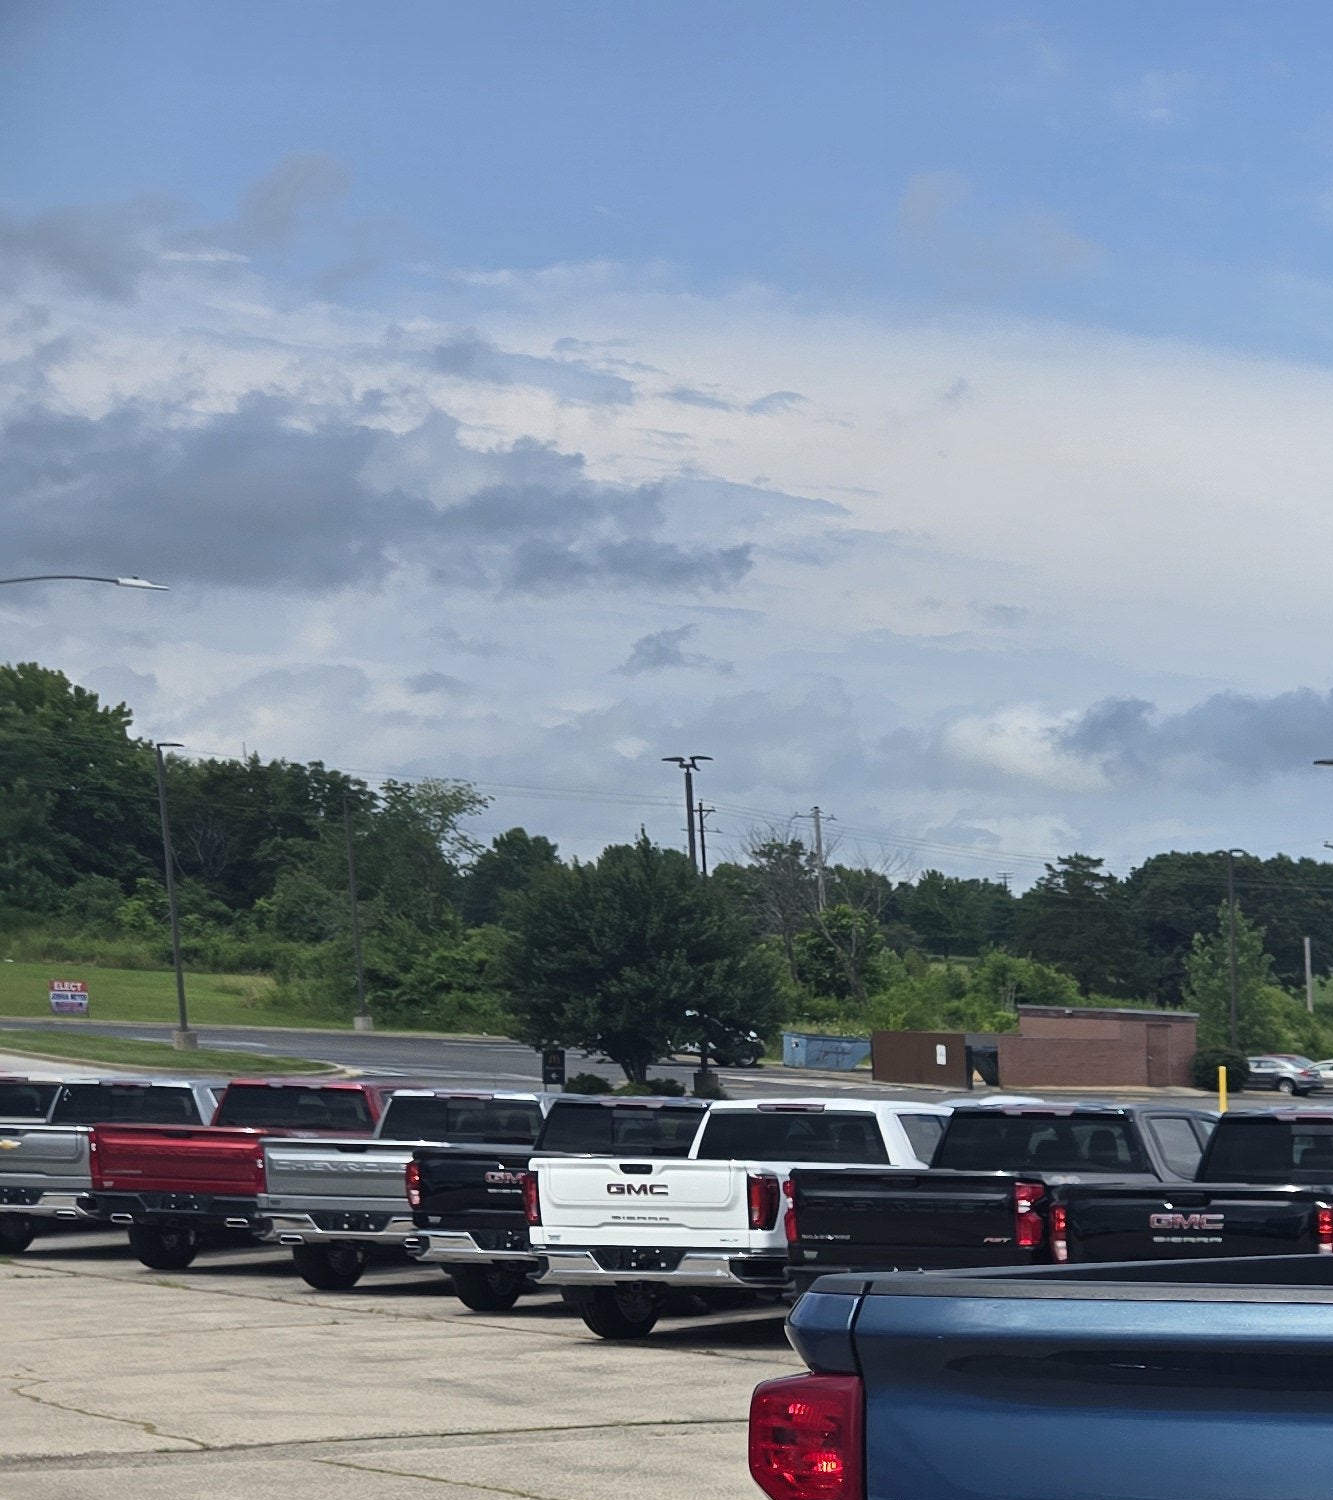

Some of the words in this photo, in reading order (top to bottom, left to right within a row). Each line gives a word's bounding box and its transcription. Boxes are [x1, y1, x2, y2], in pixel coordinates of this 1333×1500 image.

[54, 982, 82, 991] ELECT
[606, 1183, 669, 1196] GMC
[1150, 1213, 1225, 1230] GMC
